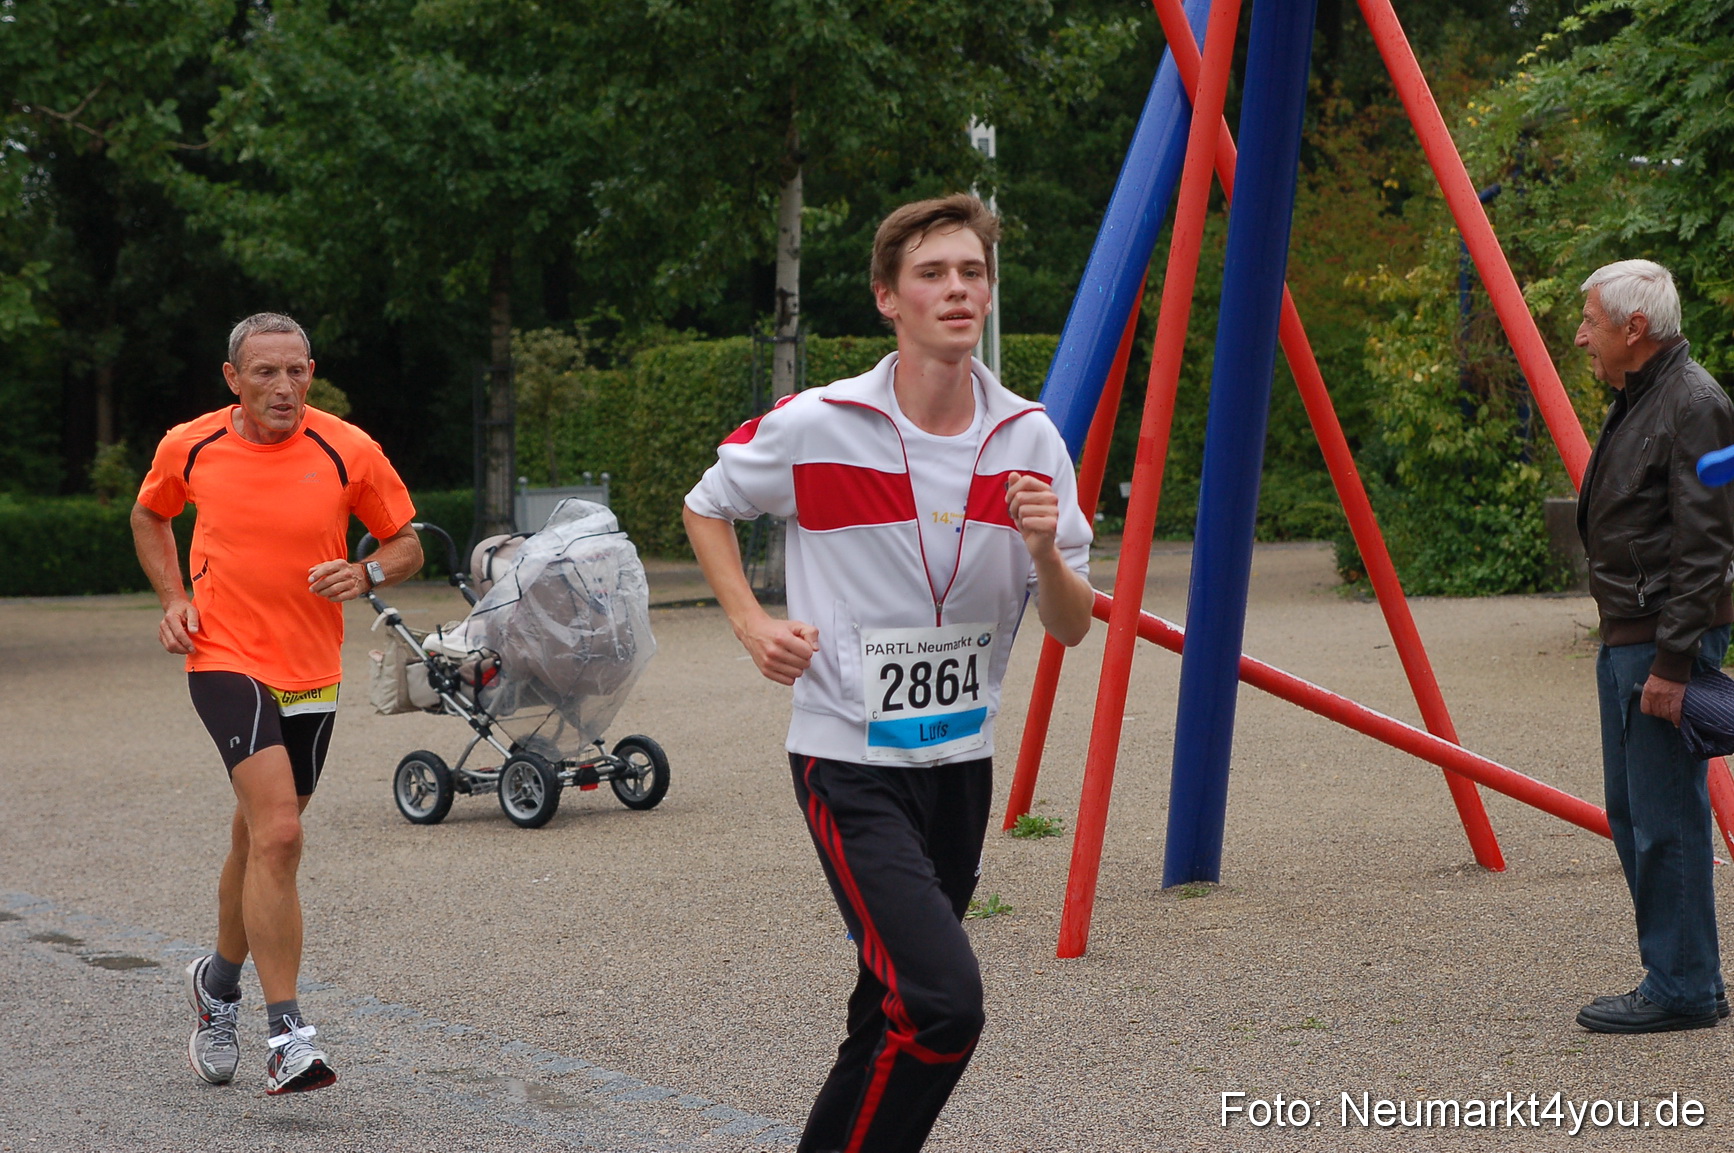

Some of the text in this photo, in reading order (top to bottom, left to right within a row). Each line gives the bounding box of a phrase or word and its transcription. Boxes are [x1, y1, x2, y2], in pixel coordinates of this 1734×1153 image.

[866, 636, 972, 656] PARTL Neumarkt
[880, 653, 979, 712] 2864
[919, 722, 949, 742] Luis
